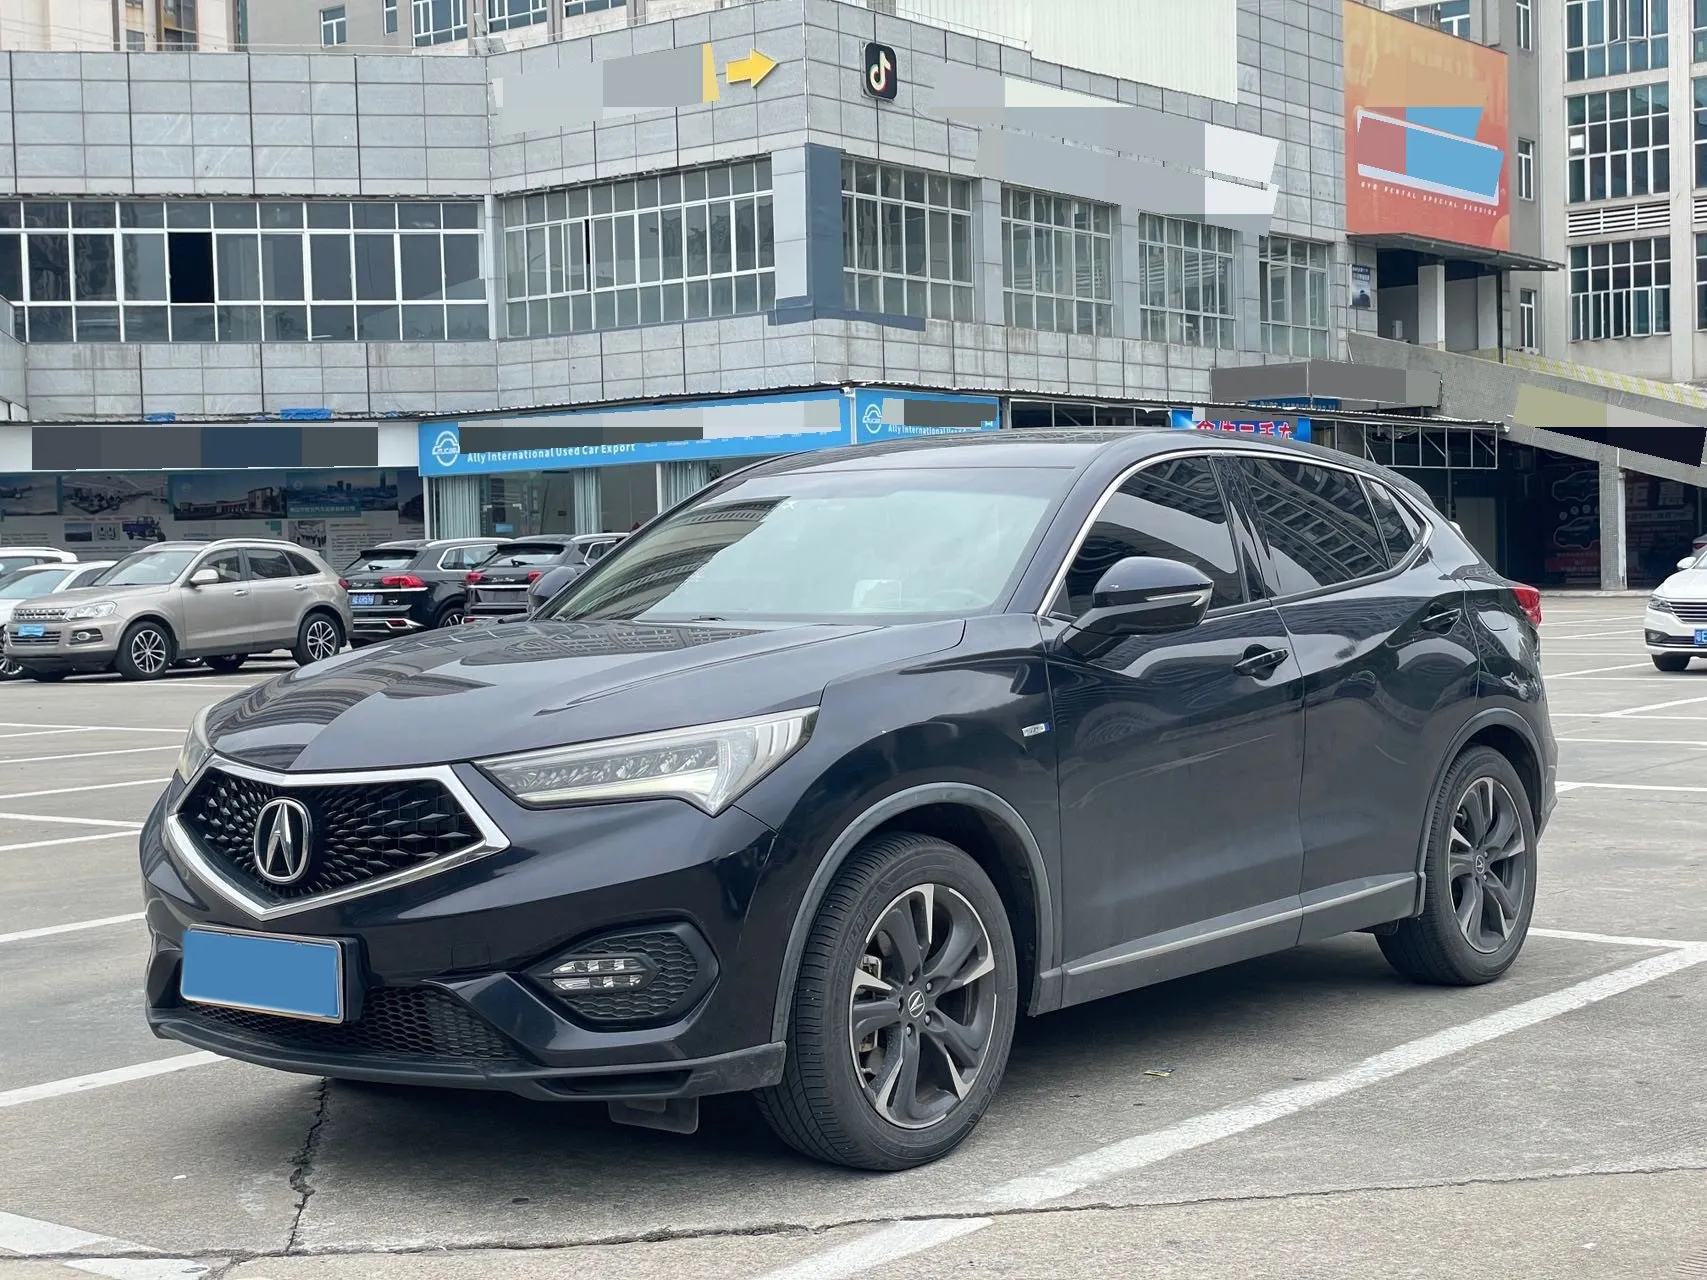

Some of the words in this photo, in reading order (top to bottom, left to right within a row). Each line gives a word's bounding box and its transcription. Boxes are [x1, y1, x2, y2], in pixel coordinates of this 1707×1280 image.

[1423, 195, 1457, 208] SPECIAL
[467, 452, 486, 464] Ally
[487, 448, 554, 462] International
[556, 447, 580, 457] Used
[582, 446, 600, 455] Car
[601, 443, 636, 455] Export
